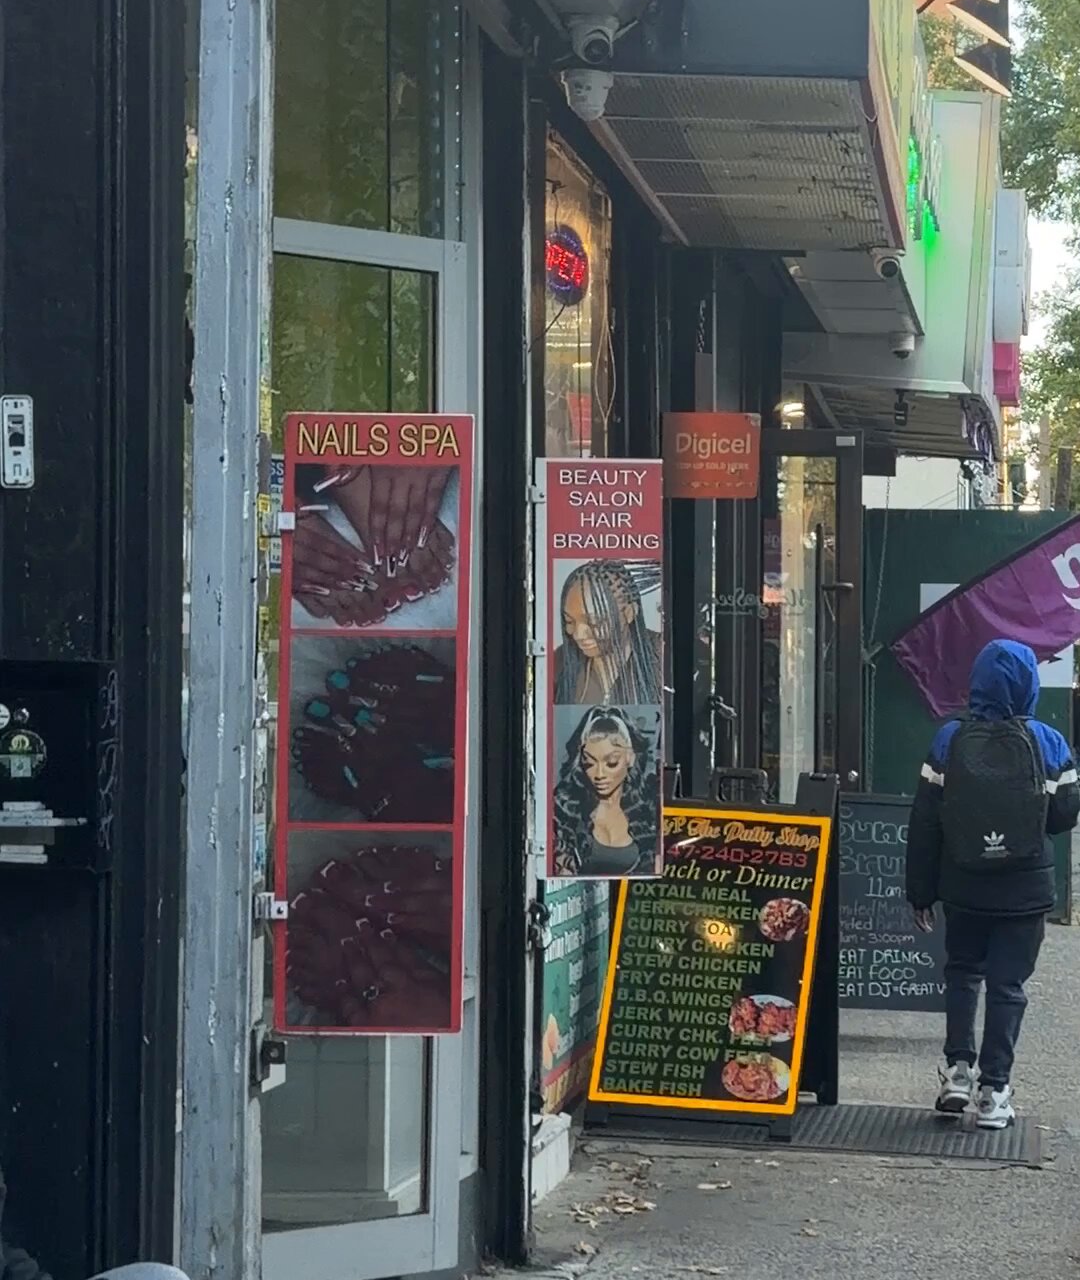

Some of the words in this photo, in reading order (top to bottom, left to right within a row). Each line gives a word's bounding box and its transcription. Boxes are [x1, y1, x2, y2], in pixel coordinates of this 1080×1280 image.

[297, 421, 390, 456] NAILS
[399, 423, 460, 457] SPA
[676, 432, 751, 459] Digicel
[559, 469, 647, 486] BEAUTY
[569, 491, 643, 507] SALON
[580, 512, 632, 528] HAIR
[553, 534, 660, 549] BRAIDING
[664, 843, 808, 869] 47-240-2783
[663, 860, 700, 881] nch
[706, 867, 731, 882] or
[734, 865, 813, 892] Dinner
[631, 882, 697, 899] OXTAIL
[701, 887, 752, 903] MEAL
[629, 900, 676, 916] JERK
[682, 903, 765, 921] CHICKEN
[626, 918, 689, 934] CURRY
[624, 934, 688, 951] CURRY
[691, 939, 775, 958] CHICKEN
[868, 932, 915, 945] 3:00pm
[621, 952, 674, 969] STEW
[678, 955, 761, 975] CHICKEN
[839, 948, 867, 965] EAT
[619, 970, 655, 986] FRY
[659, 972, 743, 991] CHICKEN
[839, 965, 863, 980] EAT
[869, 964, 917, 981] FOOD
[839, 982, 864, 997] EAT
[613, 1005, 662, 1022] JERK
[667, 1009, 730, 1026] WINGS
[611, 1023, 674, 1041] CURRY
[679, 1027, 724, 1044] CHK.
[608, 1041, 673, 1059] CURRY
[676, 1045, 720, 1061] COW
[605, 1059, 659, 1075] STEW
[663, 1062, 705, 1080] FISH
[602, 1076, 654, 1093] BAKE
[658, 1081, 702, 1097] FISH
